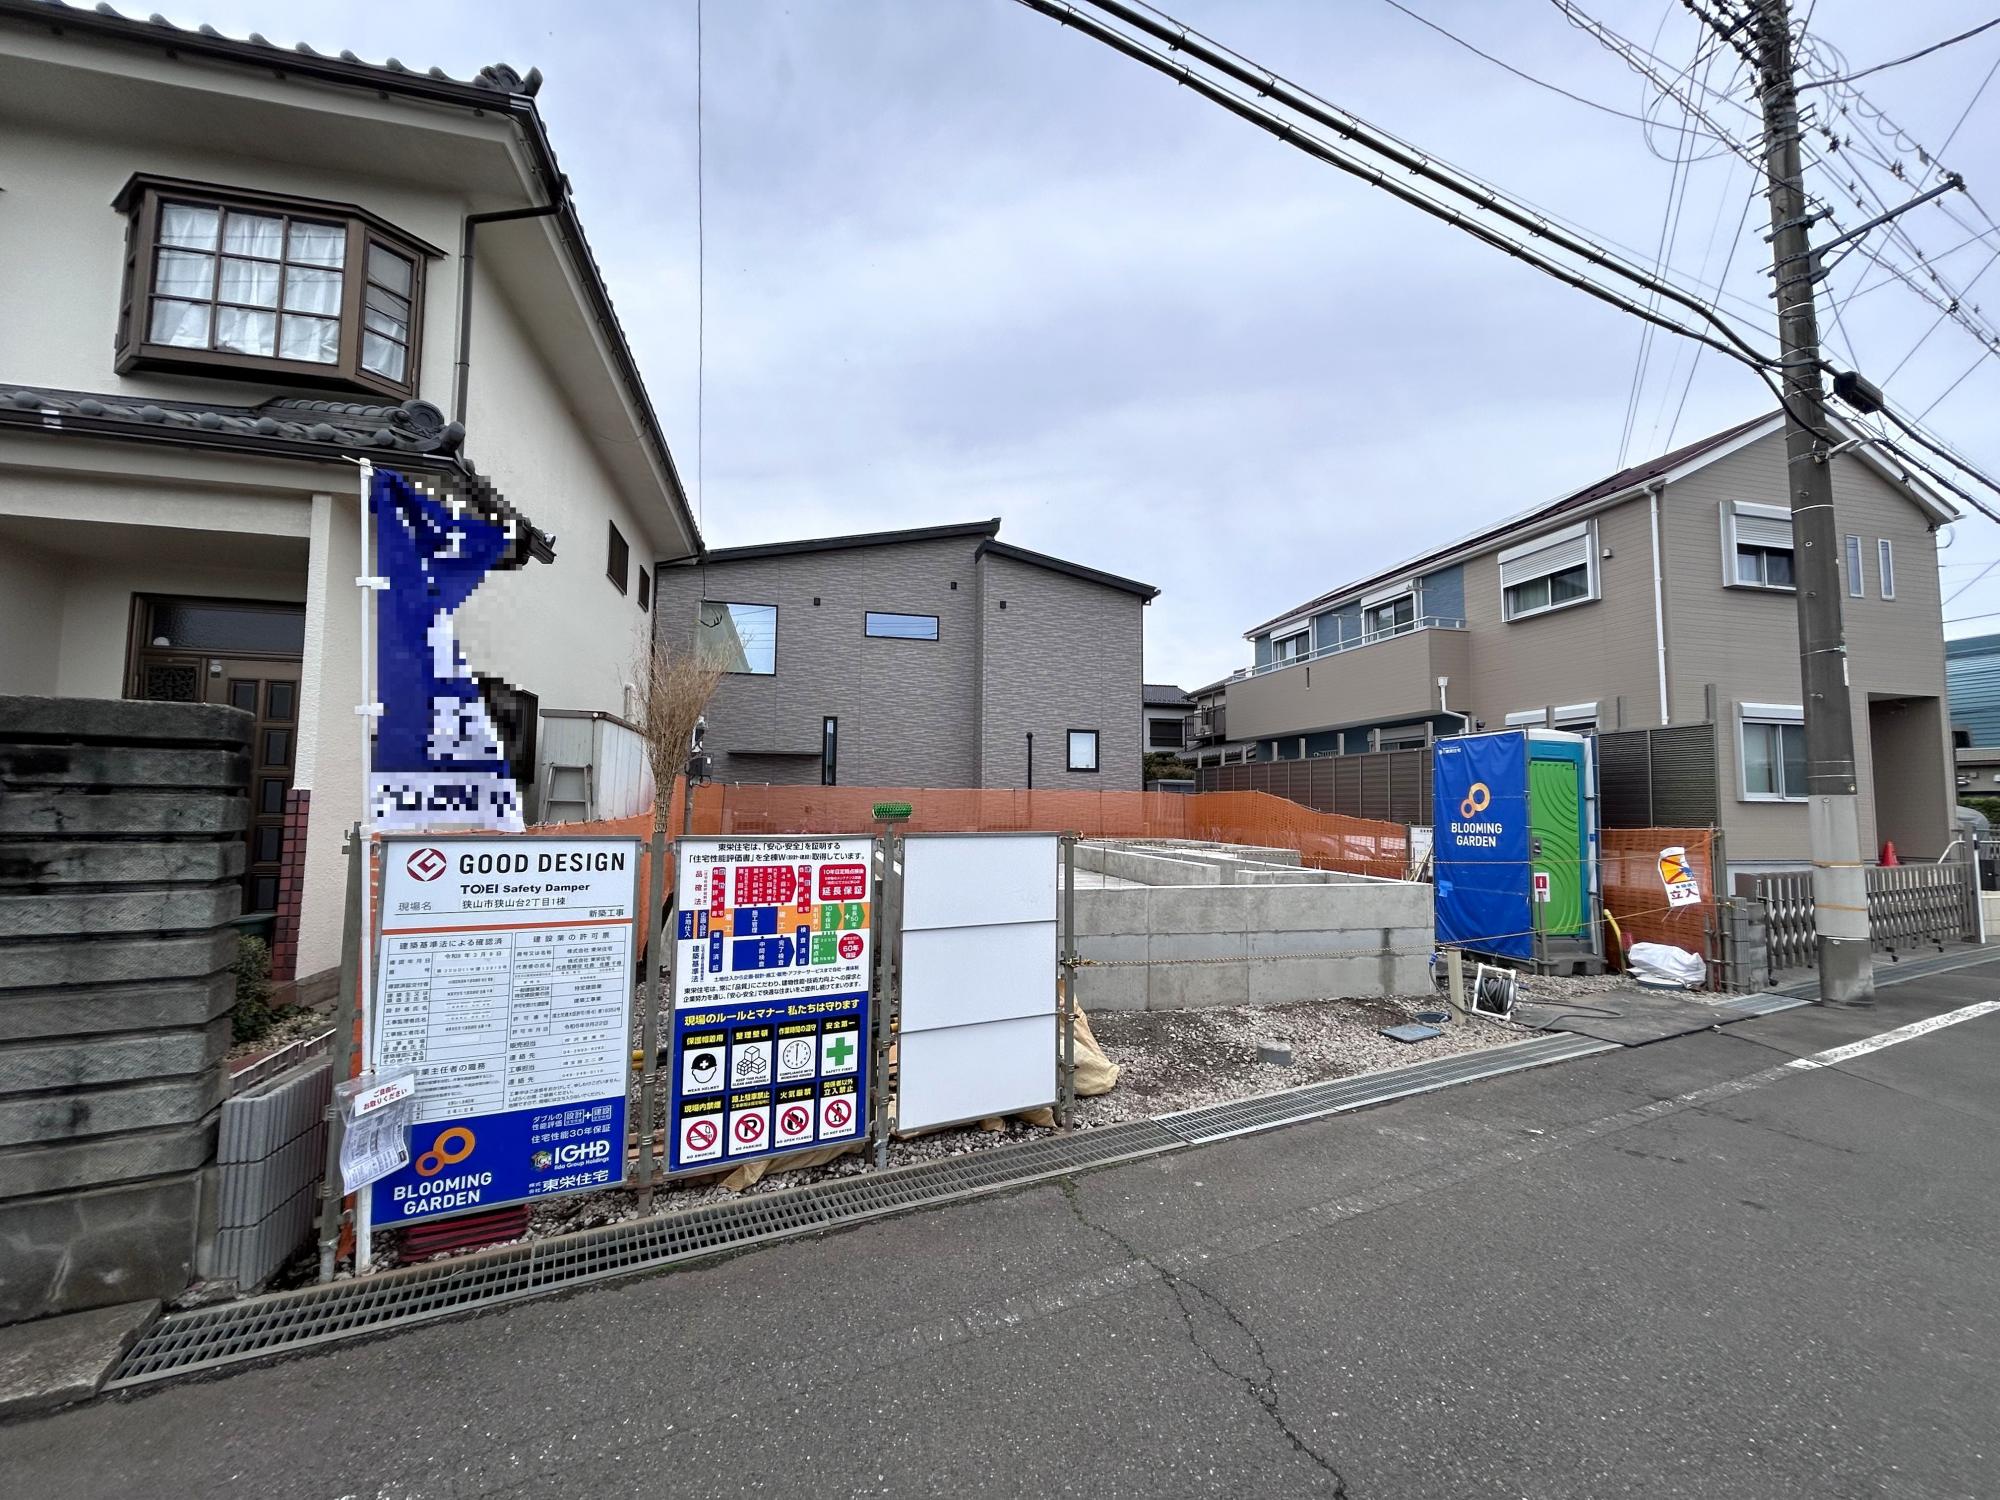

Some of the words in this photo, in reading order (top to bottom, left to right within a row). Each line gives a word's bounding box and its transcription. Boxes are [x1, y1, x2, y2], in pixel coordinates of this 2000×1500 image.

[1451, 822, 1503, 834] BLOOMING
[1456, 835, 1497, 847] GARDEN
[459, 853, 529, 874] GOOD
[538, 852, 625, 872] DESIGN
[502, 883, 542, 894] Safety
[545, 882, 590, 893] Damper
[822, 886, 863, 896] 延長保証
[398, 901, 432, 912] 現場名
[461, 897, 566, 910] 狭山市狭山台2丁目1棟
[588, 908, 624, 918] 新築工事
[825, 905, 833, 929] 10年保証
[684, 912, 692, 938] 土地仕入
[751, 910, 759, 934] 施工管理
[400, 938, 503, 950] 建築基準法による確認済
[533, 932, 610, 943] 建設業の許可票
[799, 927, 807, 965] 検査済証
[758, 941, 766, 968] 中間検査
[691, 945, 699, 983] 建築基準法
[684, 1007, 785, 1026] 現場のルールとマナー
[787, 999, 860, 1016] 私たちは守ります
[825, 1020, 856, 1030] 安全第一
[736, 1029, 768, 1040] 整理整頓
[731, 1091, 770, 1103] 路上駐車禁止
[780, 1087, 812, 1099] 火気厳禁
[824, 1086, 854, 1097] 立入禁止
[363, 1089, 408, 1111] お取りください
[533, 1113, 563, 1124] ダブルの
[565, 1111, 582, 1120] 設計
[532, 1120, 563, 1131] 性能評価
[531, 1123, 612, 1144] 住宅性能30年保証
[554, 1140, 611, 1164] IGHD
[566, 1161, 585, 1169] Group
[585, 1156, 610, 1165] Holdings
[393, 1171, 493, 1201] BLOOMING
[542, 1169, 609, 1192] 東栄住宅
[403, 1188, 481, 1216] GARDEN
